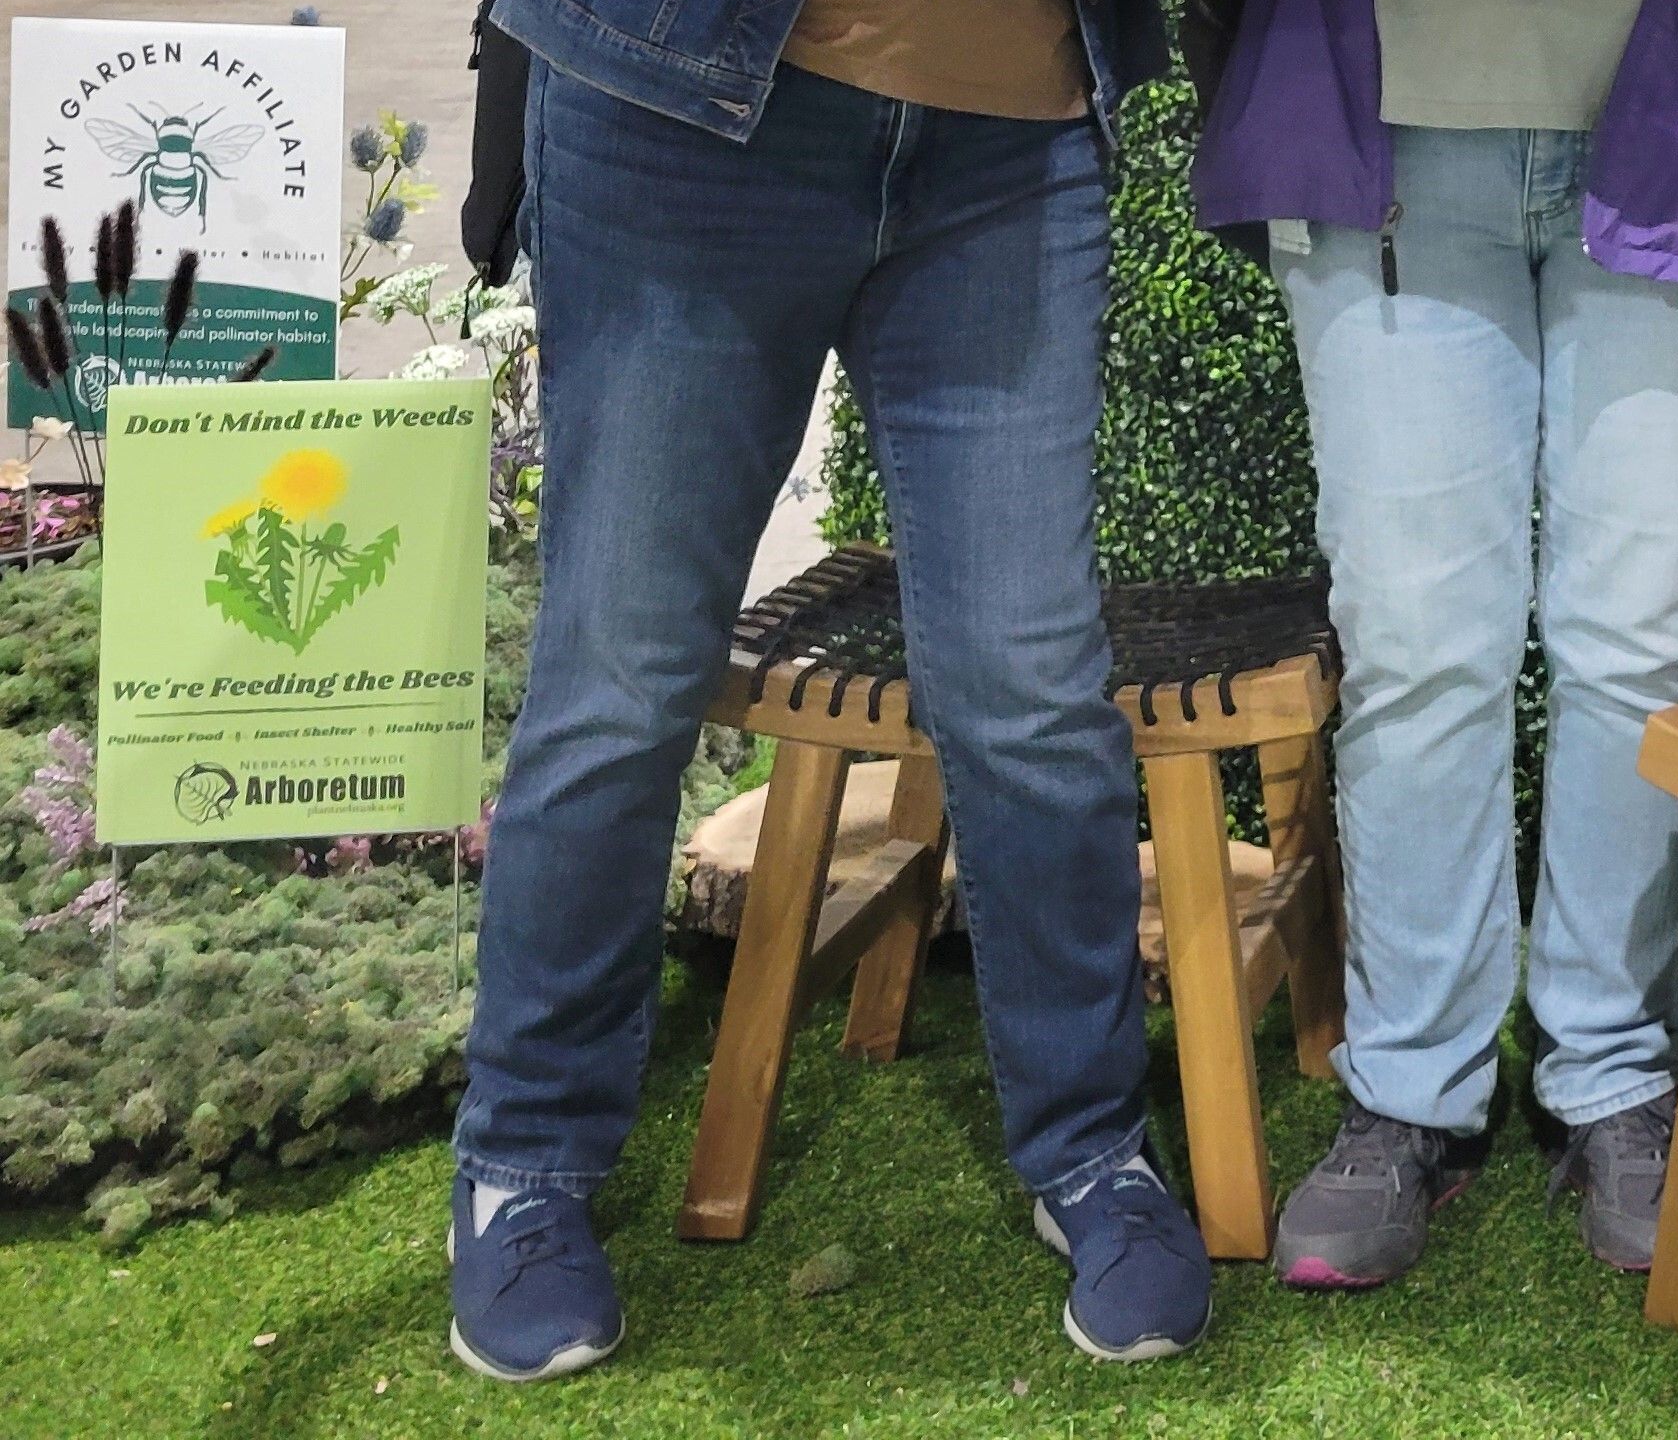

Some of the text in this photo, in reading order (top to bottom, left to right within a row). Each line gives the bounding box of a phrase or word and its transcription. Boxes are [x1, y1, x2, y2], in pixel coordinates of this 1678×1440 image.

[43, 41, 306, 198] MY GARDEN AFFILIATE
[262, 250, 325, 261] Habitat
[202, 309, 211, 319] a
[215, 308, 300, 322] commitment
[304, 310, 319, 322] to
[179, 325, 205, 340] and
[208, 326, 273, 343] pollinator
[277, 328, 331, 344] habitat.
[123, 403, 475, 435] Don't Mind the Weeds
[113, 668, 476, 702] We're Feeding the Bees
[107, 719, 476, 746] Pollinator Food Insect Shelter Healthy Soil
[239, 754, 405, 771] NEBRASKA STATEWIDE
[245, 773, 405, 806] Arboretum
